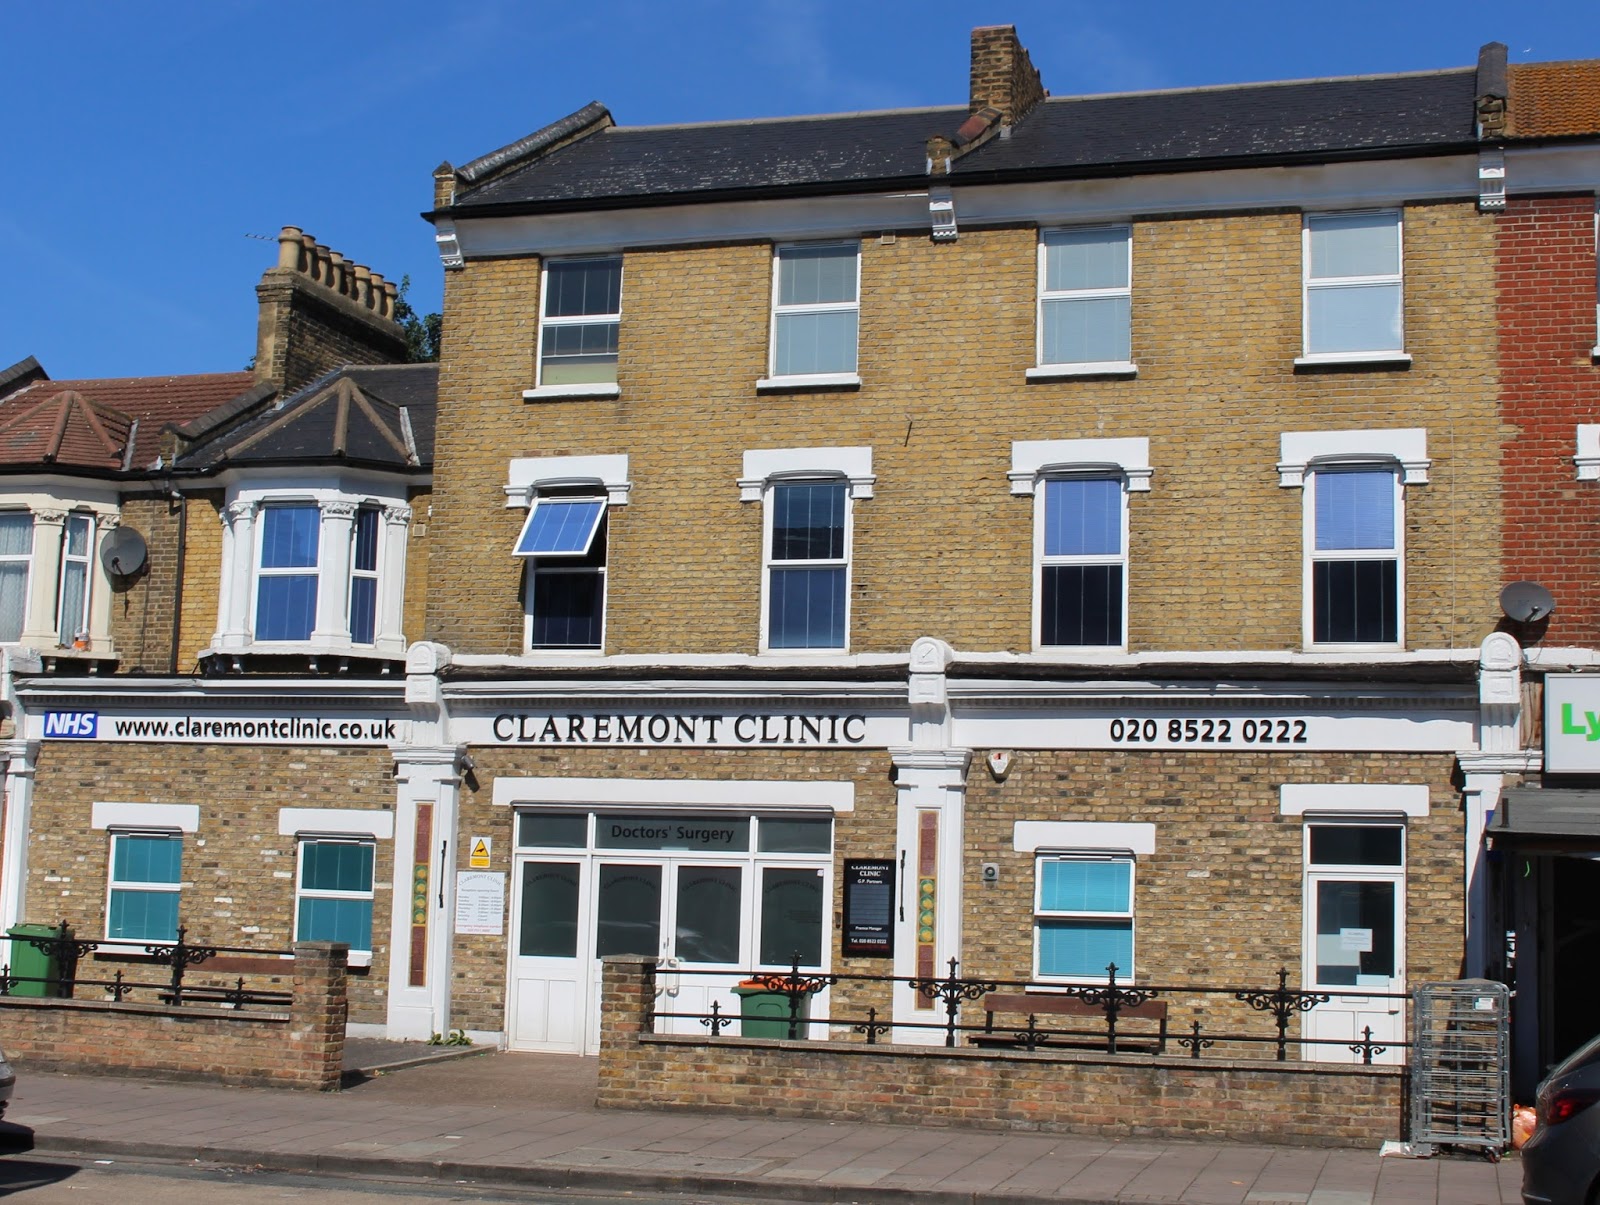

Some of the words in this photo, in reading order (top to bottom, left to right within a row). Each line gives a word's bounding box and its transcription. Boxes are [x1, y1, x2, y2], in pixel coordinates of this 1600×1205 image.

[46, 712, 96, 735] NHS
[115, 716, 396, 740] www.claremontclinic.co.uk
[493, 713, 723, 743] CLAREMONT
[734, 714, 867, 744] CLINIC
[1110, 719, 1157, 742] 020
[1167, 719, 1231, 742] 8522
[1242, 719, 1307, 743] 0222
[611, 824, 672, 839] Doctors'
[676, 826, 735, 844] Surgery
